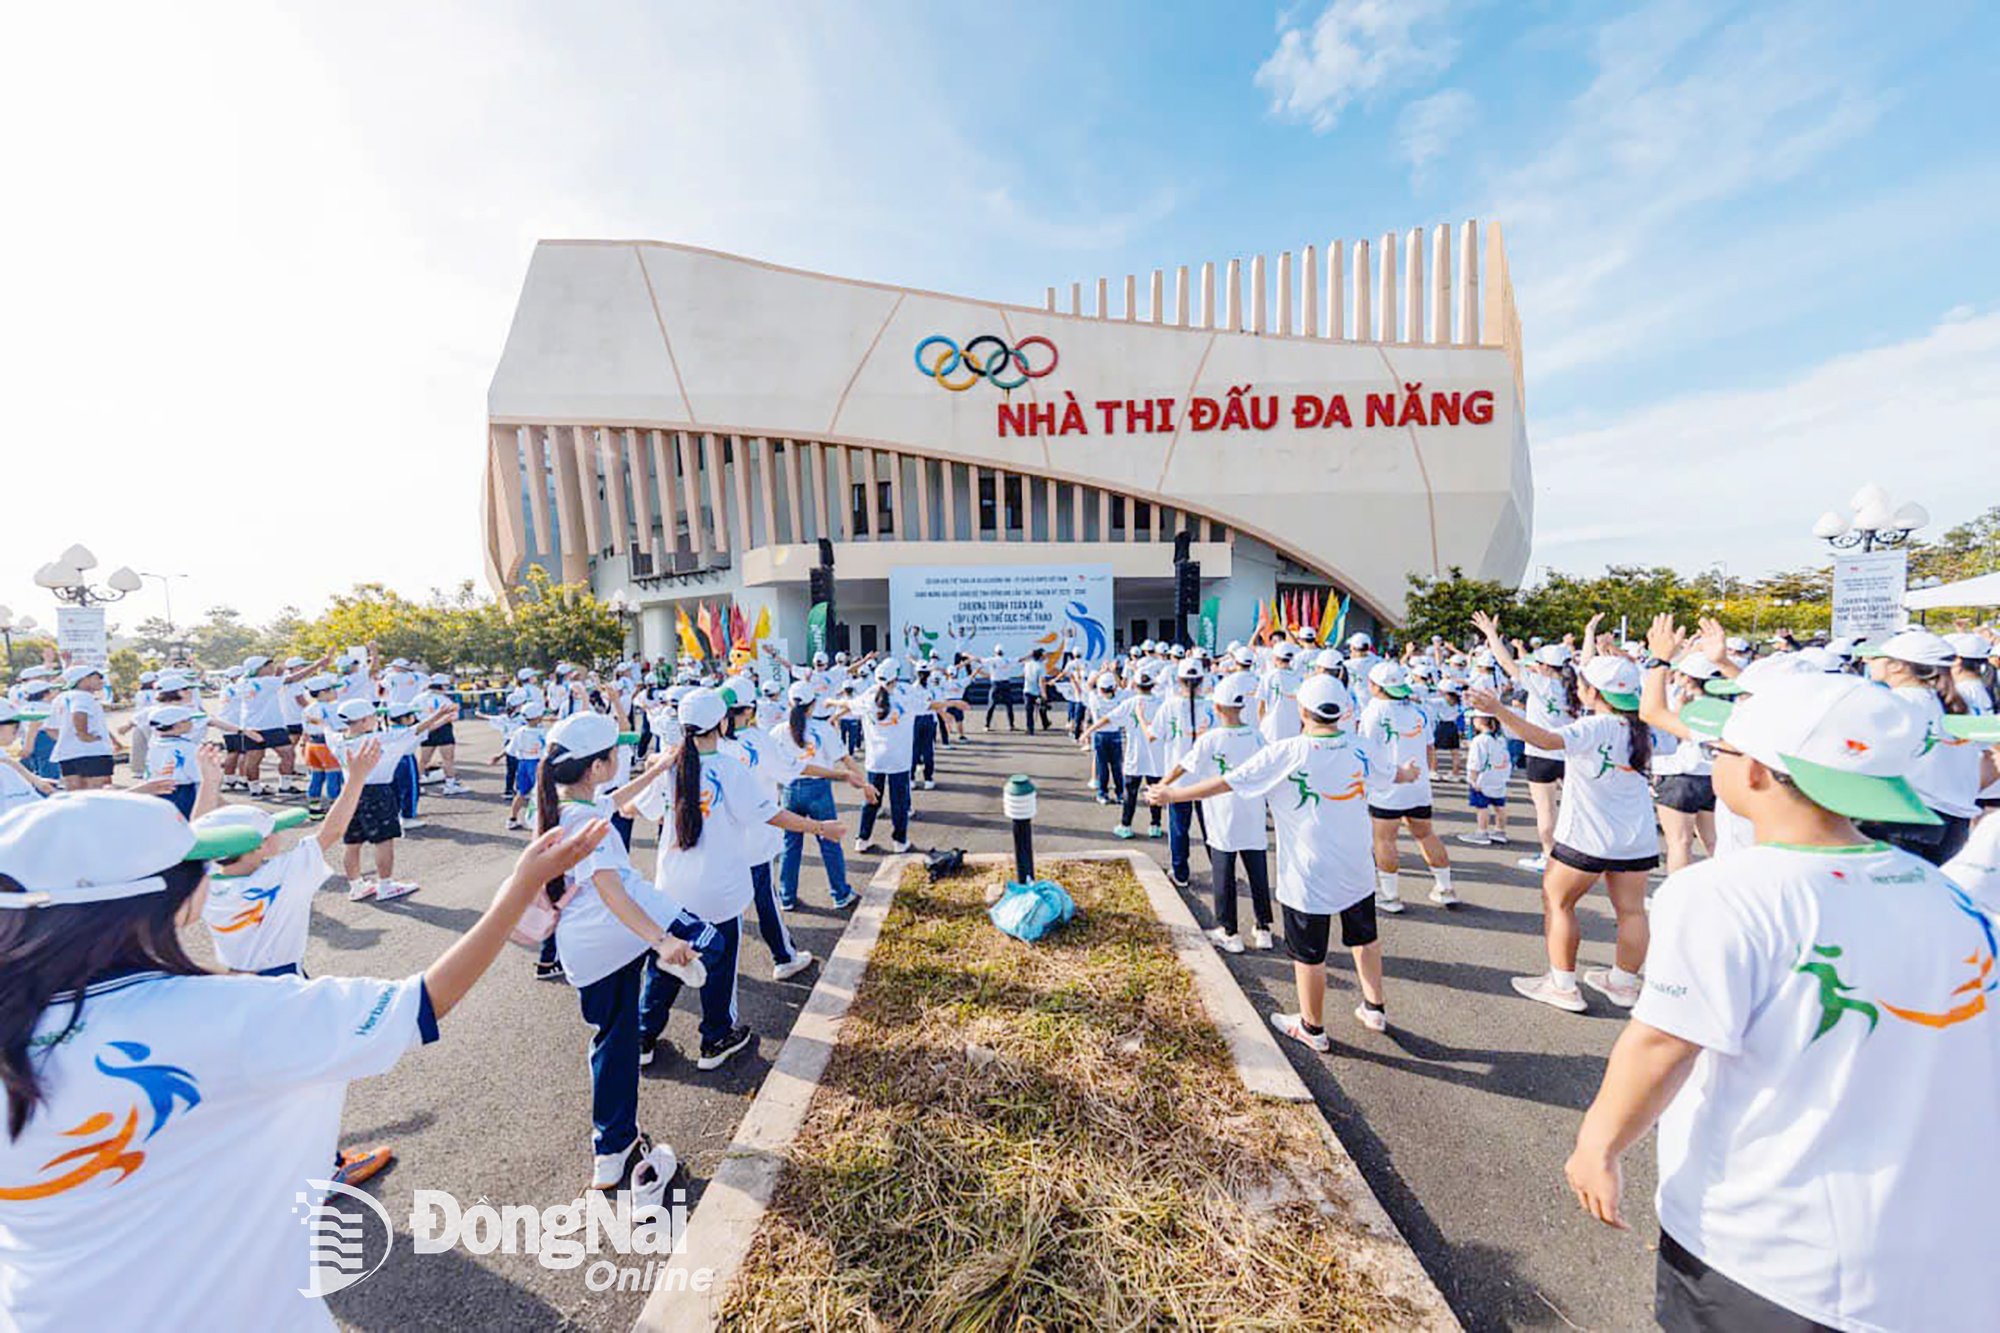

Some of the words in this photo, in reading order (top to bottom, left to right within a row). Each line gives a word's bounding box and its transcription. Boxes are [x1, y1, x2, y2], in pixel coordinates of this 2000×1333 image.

[998, 390, 1088, 437] NHÀ
[1096, 398, 1175, 434] THI
[1189, 384, 1278, 431] ĐẤU
[1292, 394, 1352, 429] ĐA
[1366, 382, 1494, 427] NĂNG
